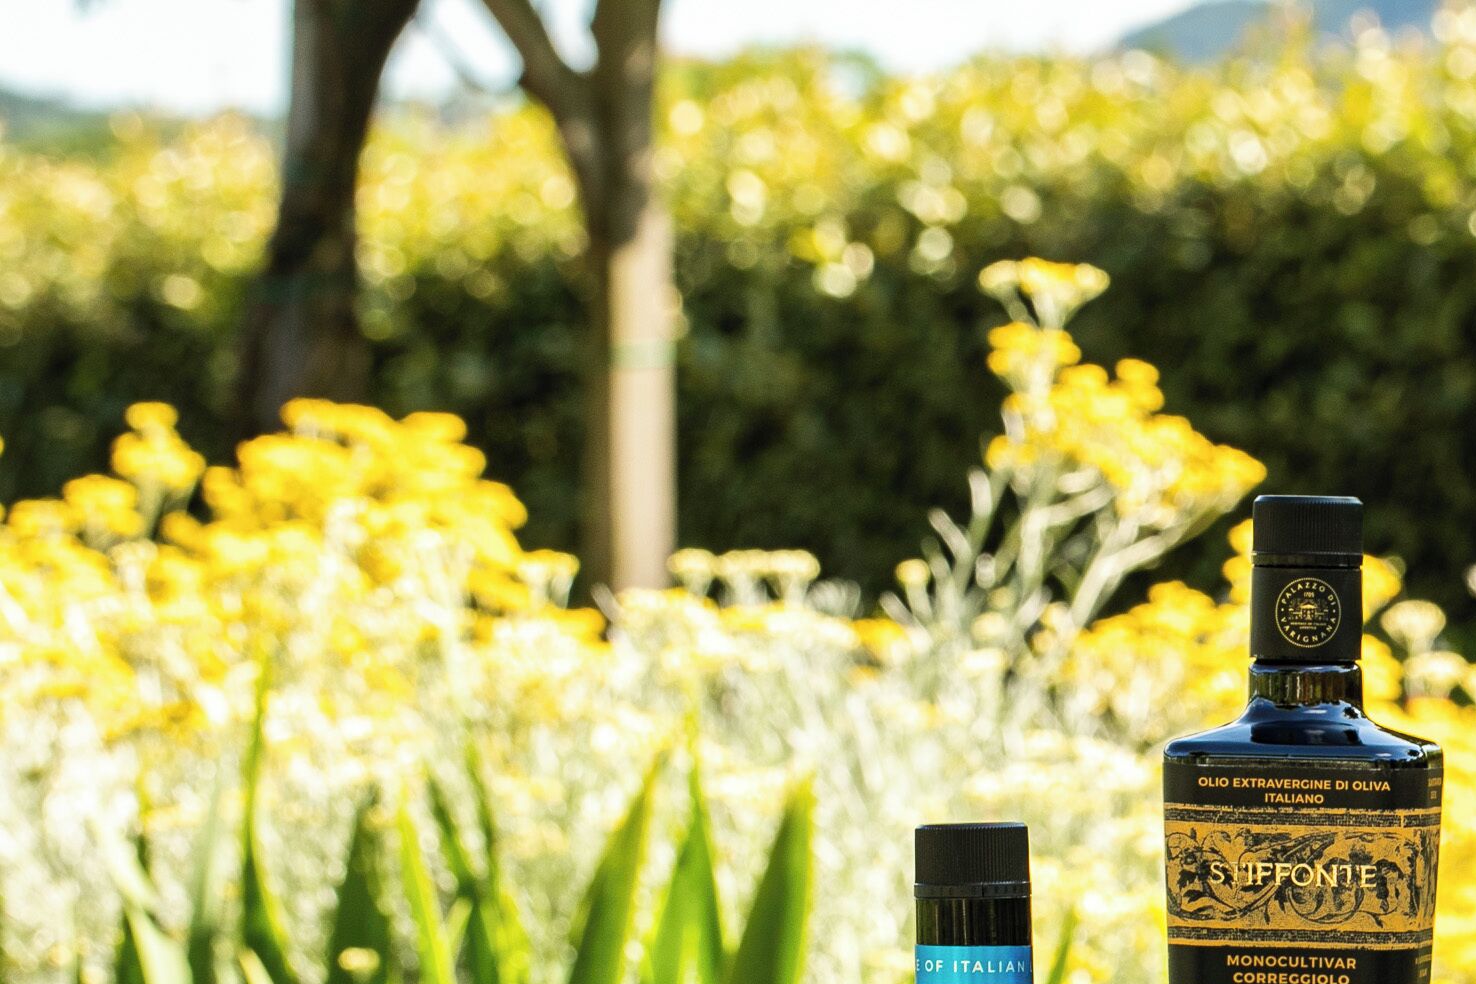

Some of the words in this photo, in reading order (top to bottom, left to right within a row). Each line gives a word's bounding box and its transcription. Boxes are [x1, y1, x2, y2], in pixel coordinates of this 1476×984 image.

[1282, 582, 1326, 604] PALAZZO
[1328, 594, 1336, 606] DI
[1281, 617, 1336, 642] VARIGNANA
[1198, 777, 1229, 788] OLIO
[1232, 778, 1331, 790] EXTRAVERGINE
[1335, 780, 1348, 790] DI
[1352, 780, 1390, 792] OLIVA
[1264, 793, 1324, 804] ITALIANO
[1210, 862, 1377, 888] STIFFONTE
[924, 960, 944, 972] OF
[953, 960, 1025, 973] ITALIAN
[1226, 954, 1356, 970] MONOCULTIVAR
